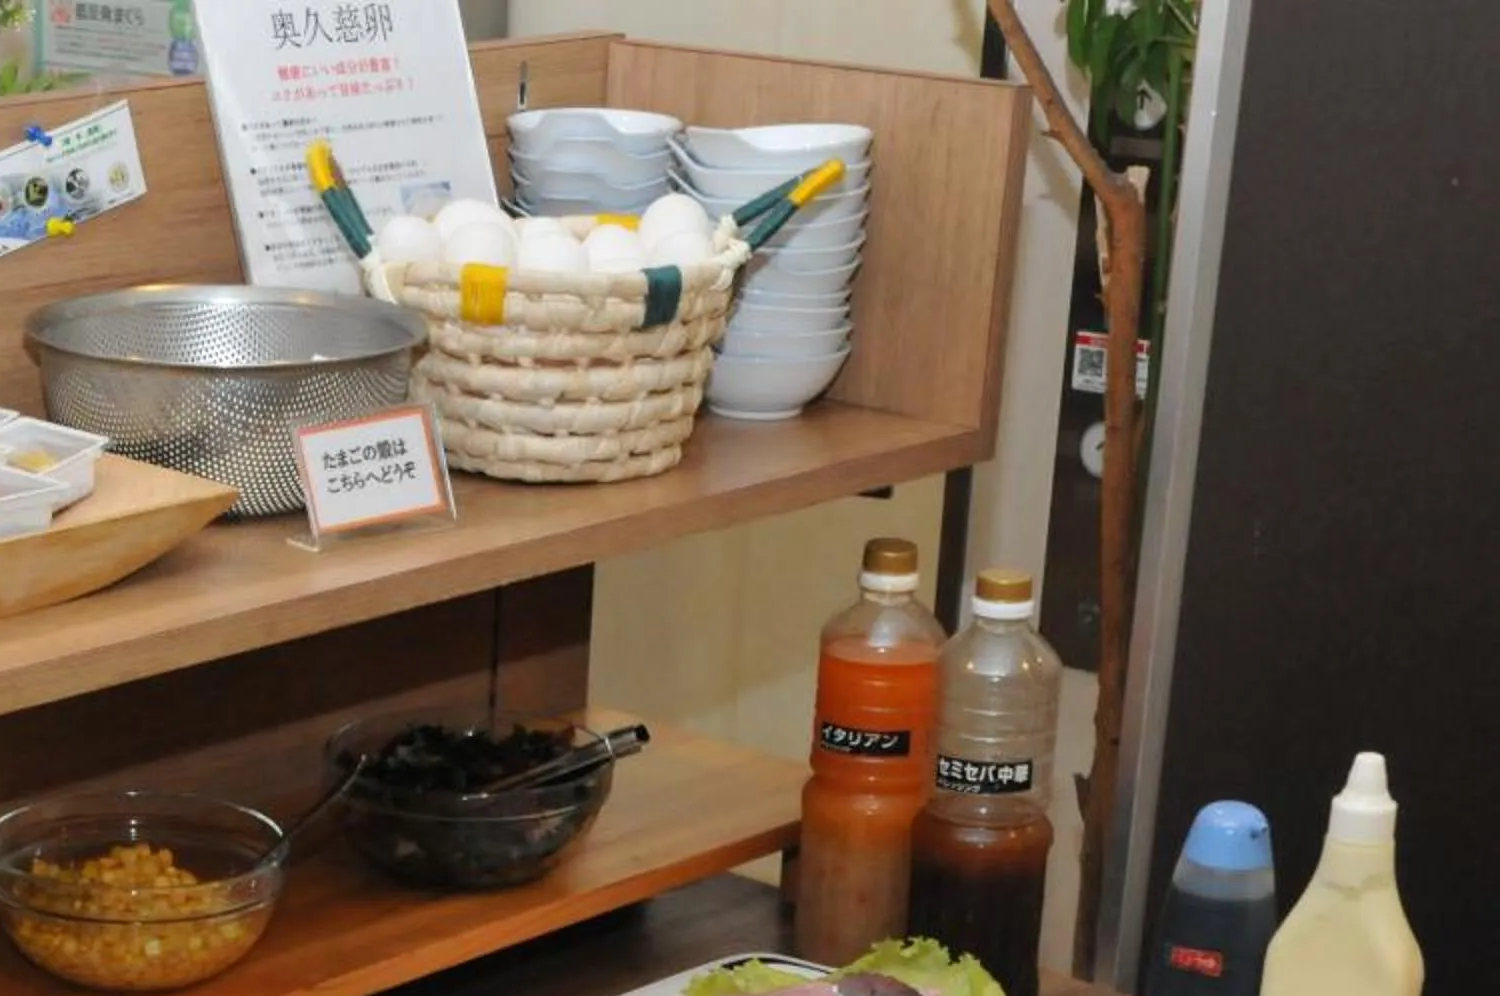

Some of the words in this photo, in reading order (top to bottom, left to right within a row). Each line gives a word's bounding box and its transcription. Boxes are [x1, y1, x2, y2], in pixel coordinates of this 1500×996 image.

[271, 2, 393, 50] 奥久慈卵
[326, 461, 416, 494] こちらへどうぞ
[822, 725, 899, 749] イタリアン
